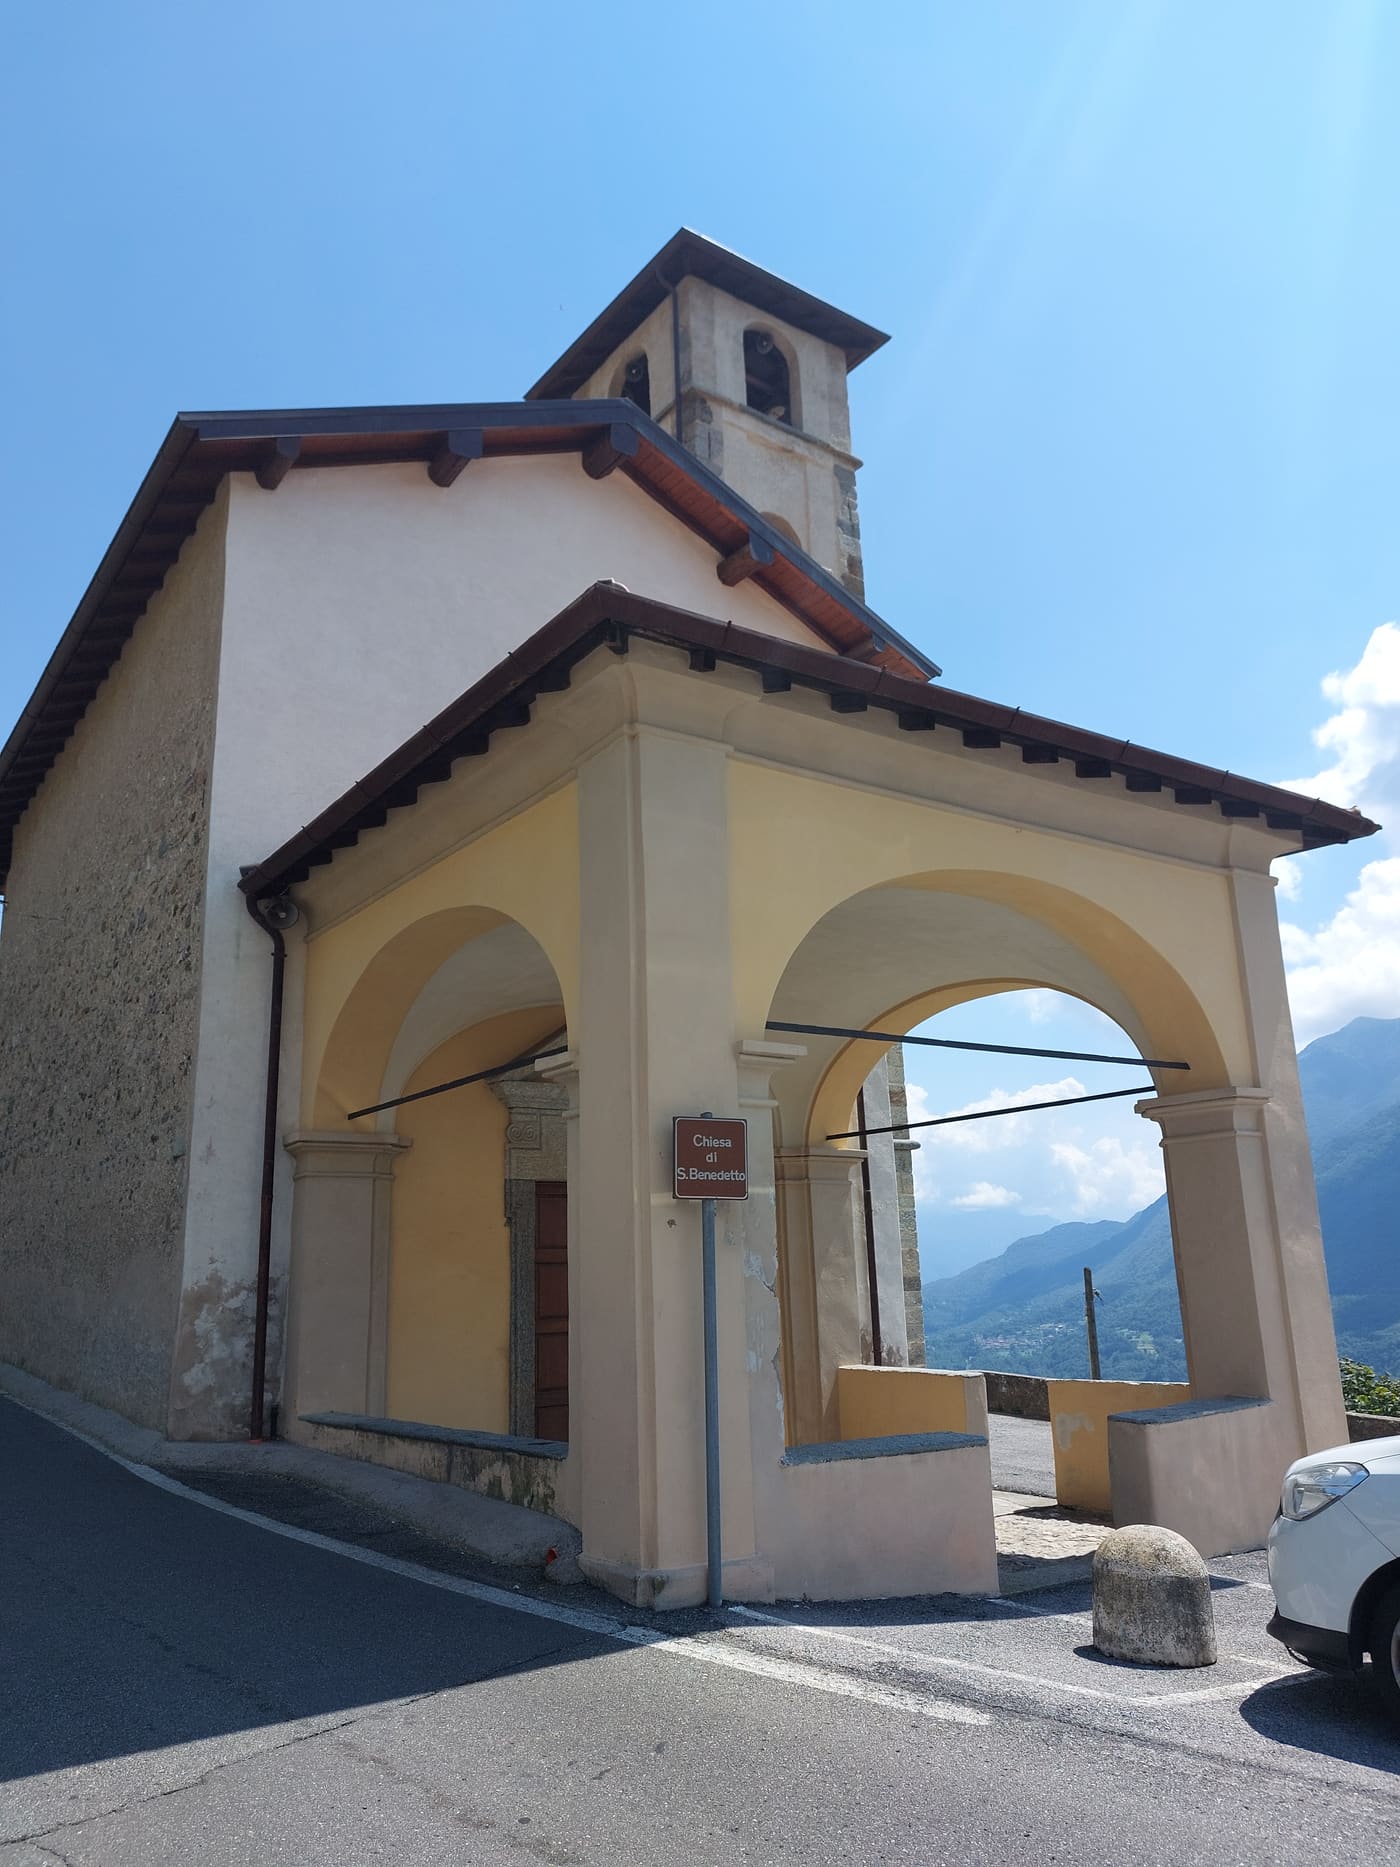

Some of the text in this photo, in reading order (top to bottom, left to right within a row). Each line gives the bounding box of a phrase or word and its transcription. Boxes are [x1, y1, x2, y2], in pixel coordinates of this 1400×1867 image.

[693, 1134, 732, 1147] Chiesa
[705, 1152, 717, 1162] di
[677, 1167, 745, 1180] S.Benedetto
